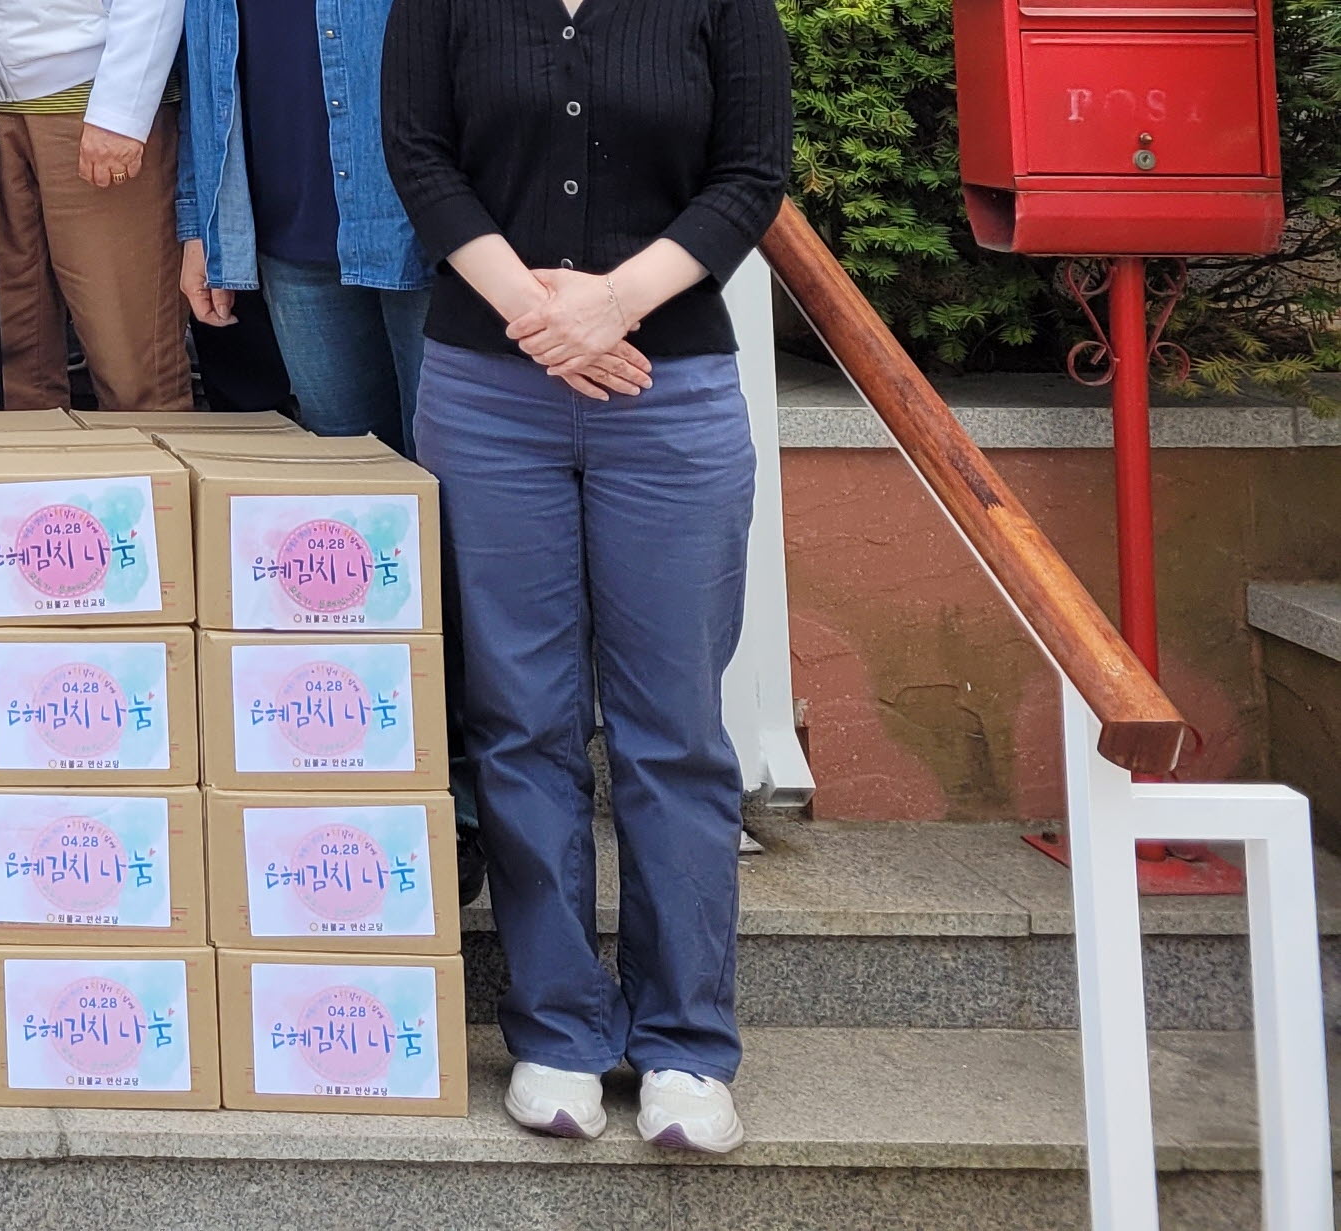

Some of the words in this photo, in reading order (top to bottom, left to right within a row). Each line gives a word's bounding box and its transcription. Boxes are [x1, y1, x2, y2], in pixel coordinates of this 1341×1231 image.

[43, 522, 81, 535] 04.28
[307, 538, 345, 550] 04.28
[61, 681, 99, 693] 04.28
[305, 680, 343, 692] 04.28
[60, 835, 99, 848] 04.28
[320, 843, 359, 855] 04.28
[79, 996, 118, 1009] 04.28
[327, 1005, 366, 1018] 04.28
